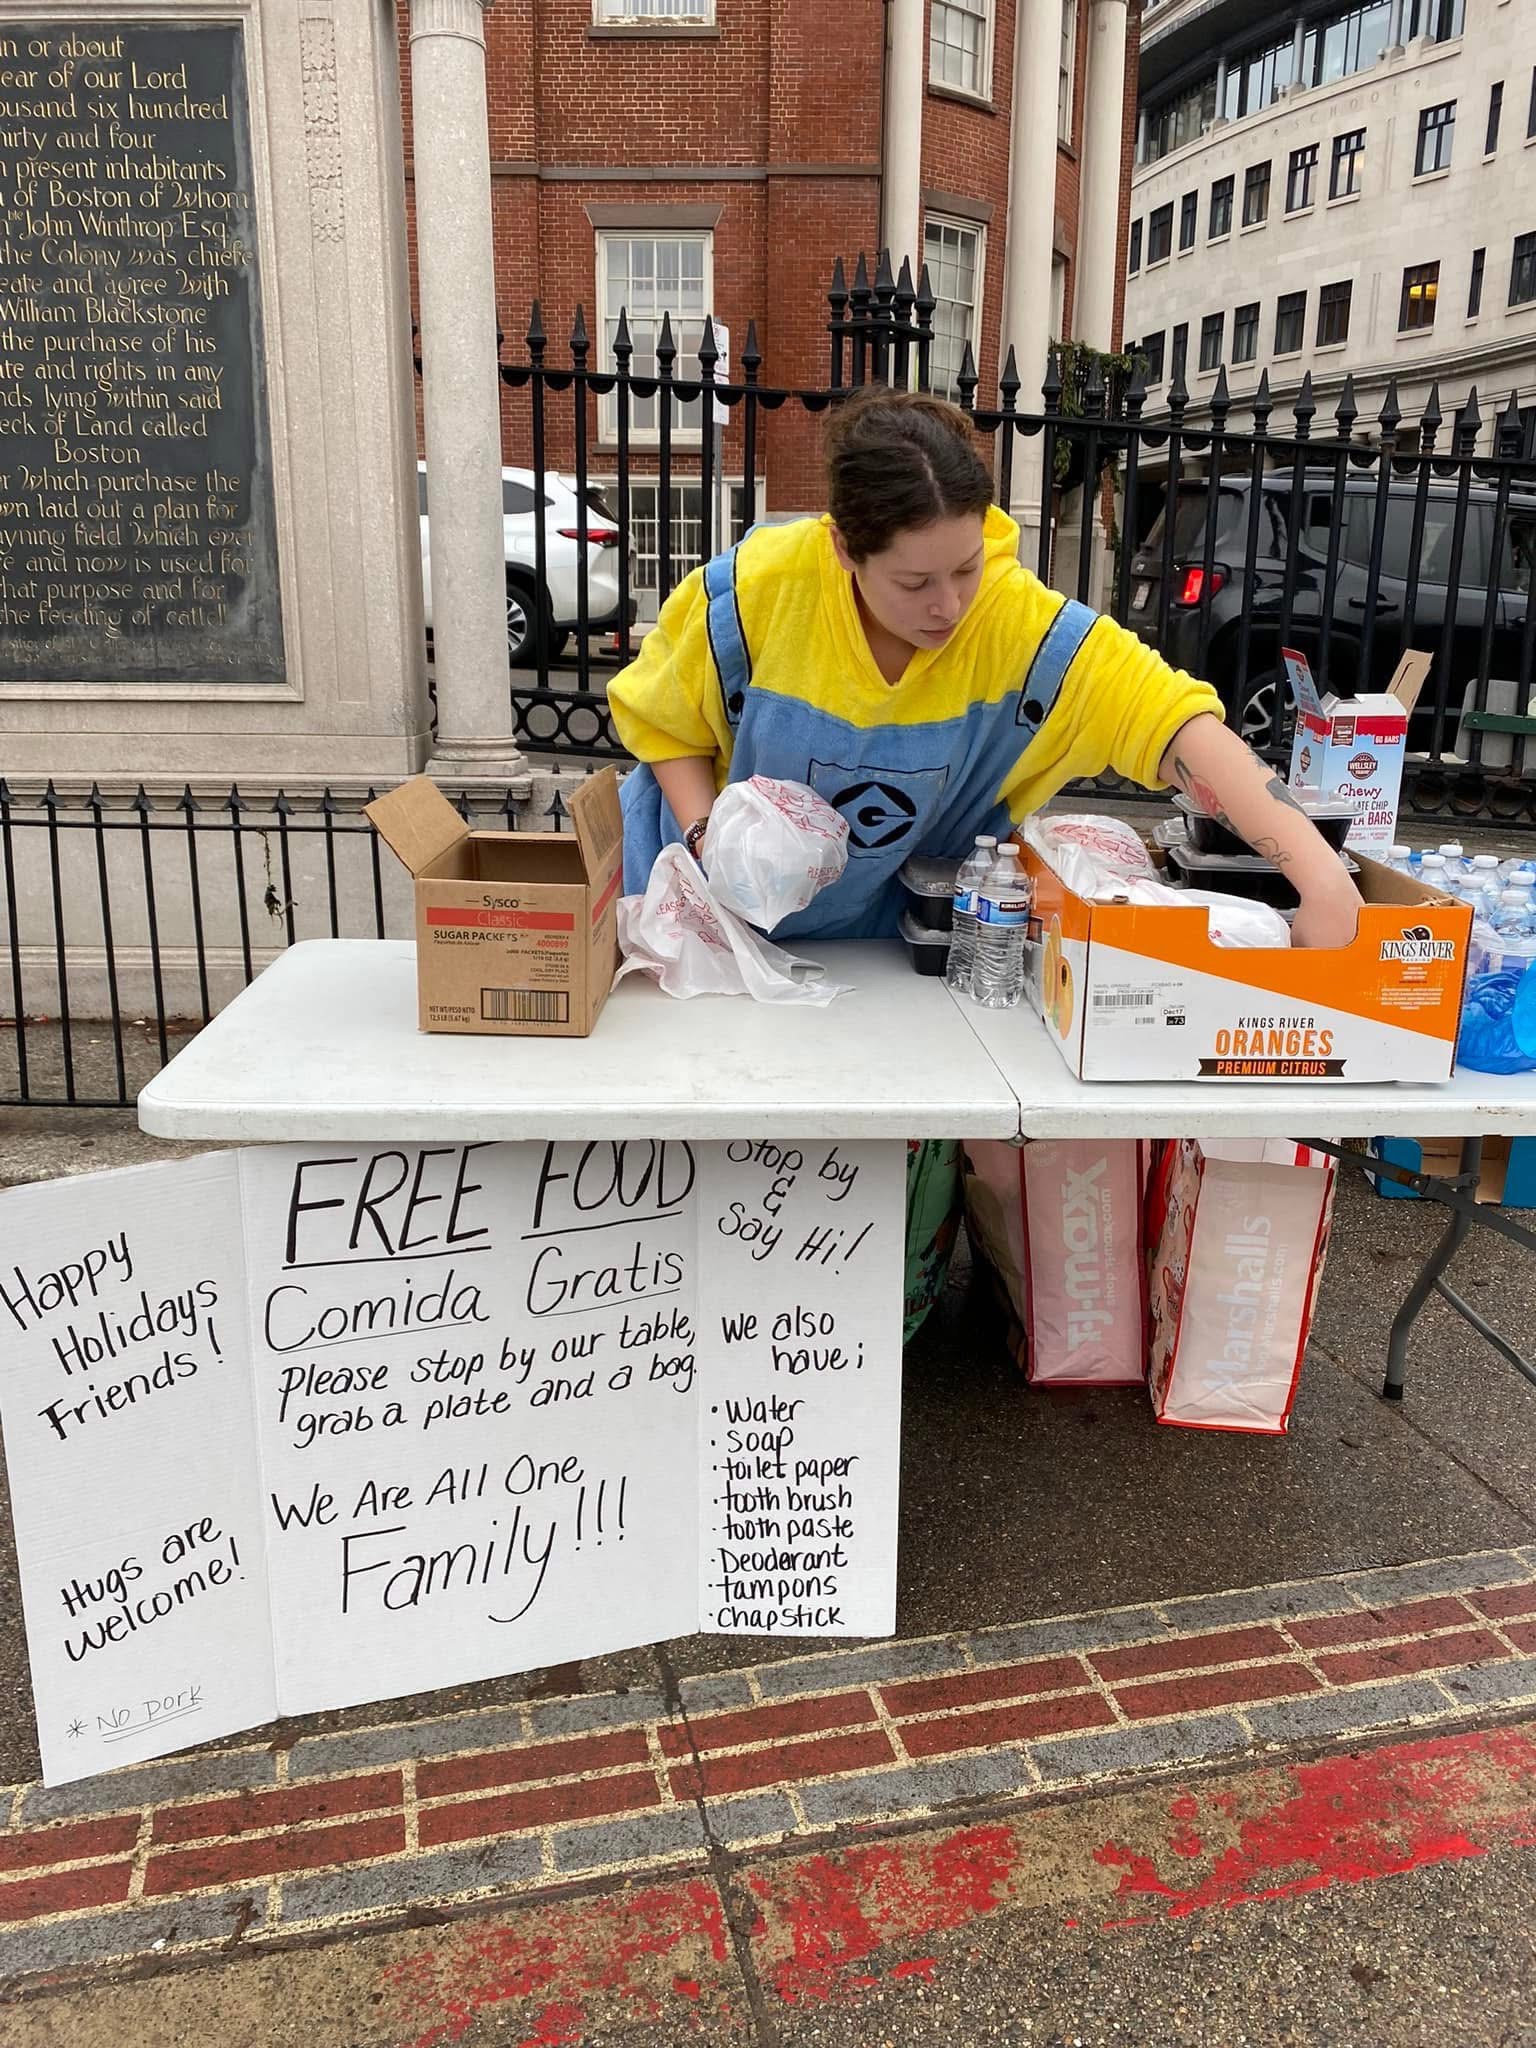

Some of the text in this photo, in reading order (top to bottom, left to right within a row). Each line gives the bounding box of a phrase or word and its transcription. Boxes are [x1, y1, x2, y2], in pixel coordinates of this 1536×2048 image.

[28, 40, 51, 57] or
[59, 32, 124, 58] about
[49, 60, 74, 88] of
[85, 71, 122, 88] our
[132, 61, 187, 89] Lord
[88, 95, 119, 119] six
[129, 93, 228, 120] hundred
[56, 123, 100, 149] and
[109, 121, 156, 149] four
[16, 158, 97, 189] present
[106, 153, 226, 181] inhabitants
[14, 180, 38, 207] of
[50, 180, 131, 208] Boston
[140, 181, 163, 208] of
[19, 209, 73, 240] John
[77, 210, 173, 248] Winthrop
[42, 238, 121, 276] Colony
[52, 270, 93, 294] and
[104, 276, 167, 307] agree
[0, 296, 207, 324] William Blackstone
[1, 326, 217, 360] the purchase of his
[35, 356, 76, 380] and
[84, 356, 146, 391] rights
[156, 357, 176, 381] in
[184, 364, 224, 390] any
[44, 383, 97, 419] lying
[178, 385, 222, 409] said
[44, 410, 66, 435] of
[75, 411, 133, 436] Land
[142, 411, 208, 437] called
[54, 437, 141, 464] Boston
[98, 468, 197, 499] purchase
[206, 469, 240, 492] the
[37, 494, 78, 518] laid
[87, 499, 122, 518] out
[133, 503, 145, 519] a
[154, 496, 200, 528] plan
[206, 494, 238, 520] for
[75, 521, 121, 545] field
[26, 553, 67, 573] and
[135, 551, 152, 574] is
[160, 550, 213, 573] used
[47, 583, 133, 608] purpose
[143, 577, 183, 600] and
[1338, 784, 1382, 799] Chewy
[1371, 801, 1388, 811] CHIP
[1367, 811, 1393, 826] BARS
[483, 895, 520, 909] Sysco
[477, 912, 524, 928] Classic
[434, 930, 469, 941] SUGAR
[472, 931, 518, 942] PACKETS
[1381, 942, 1453, 959] KINGS RIVER
[1238, 1017, 1315, 1030] KINGS RIVER
[1215, 1029, 1335, 1057] ORANGES
[1216, 1061, 1327, 1076] PREMIUM CITRUS
[727, 1139, 859, 1201] Stop by
[285, 1139, 696, 1264] FREE FOOD
[718, 1202, 874, 1275] Say Hi!
[0, 1231, 134, 1330] Happy
[264, 1242, 685, 1352] Comida Gratis
[772, 1305, 834, 1341] also
[410, 1349, 485, 1387] stop
[500, 1337, 537, 1384] by
[552, 1332, 605, 1362] our
[619, 1308, 697, 1350] table,
[293, 1405, 375, 1449] grab
[383, 1402, 407, 1426] a
[423, 1388, 511, 1431] plate
[530, 1371, 595, 1408] and
[608, 1364, 632, 1391] a
[725, 1394, 806, 1424] Water
[720, 1456, 860, 1486] toilet paper
[272, 1454, 585, 1531] We Are All One
[720, 1479, 852, 1513] tooth brush
[722, 1513, 854, 1545] tooth paste
[61, 1517, 223, 1617] Hugs are
[63, 1536, 246, 1662] welcome!
[715, 1575, 838, 1606] tampons
